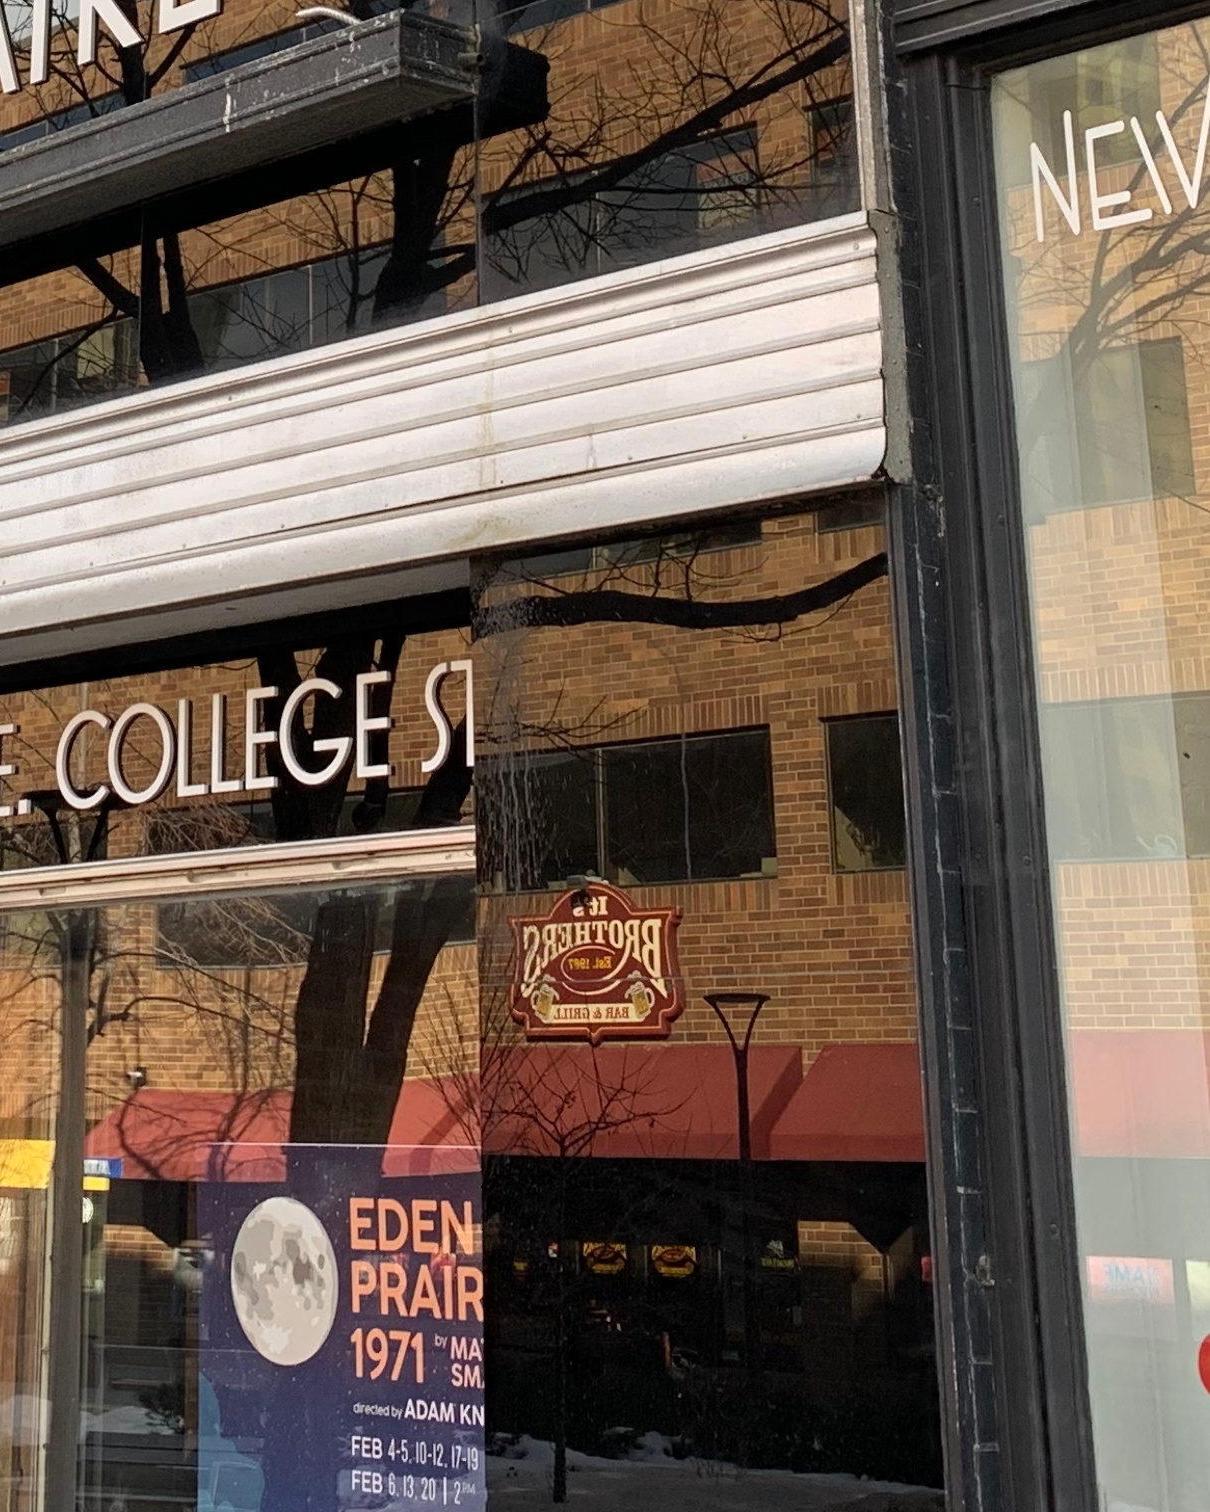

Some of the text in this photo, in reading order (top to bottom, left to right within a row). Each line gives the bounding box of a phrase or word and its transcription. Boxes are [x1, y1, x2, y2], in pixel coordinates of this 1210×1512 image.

[1030, 76, 1210, 243] NEW
[55, 669, 393, 811] COLLEGE
[349, 1197, 474, 1256] EDEN
[350, 1260, 484, 1322] PRAIR
[350, 1327, 485, 1384] 1971 by MA
[451, 1362, 485, 1389] SM
[353, 1401, 390, 1417] directed
[391, 1405, 404, 1420] by
[404, 1398, 455, 1424] ADAM
[351, 1435, 383, 1460] FEB
[351, 1469, 383, 1494] FEB
[421, 1477, 436, 1501] 20
